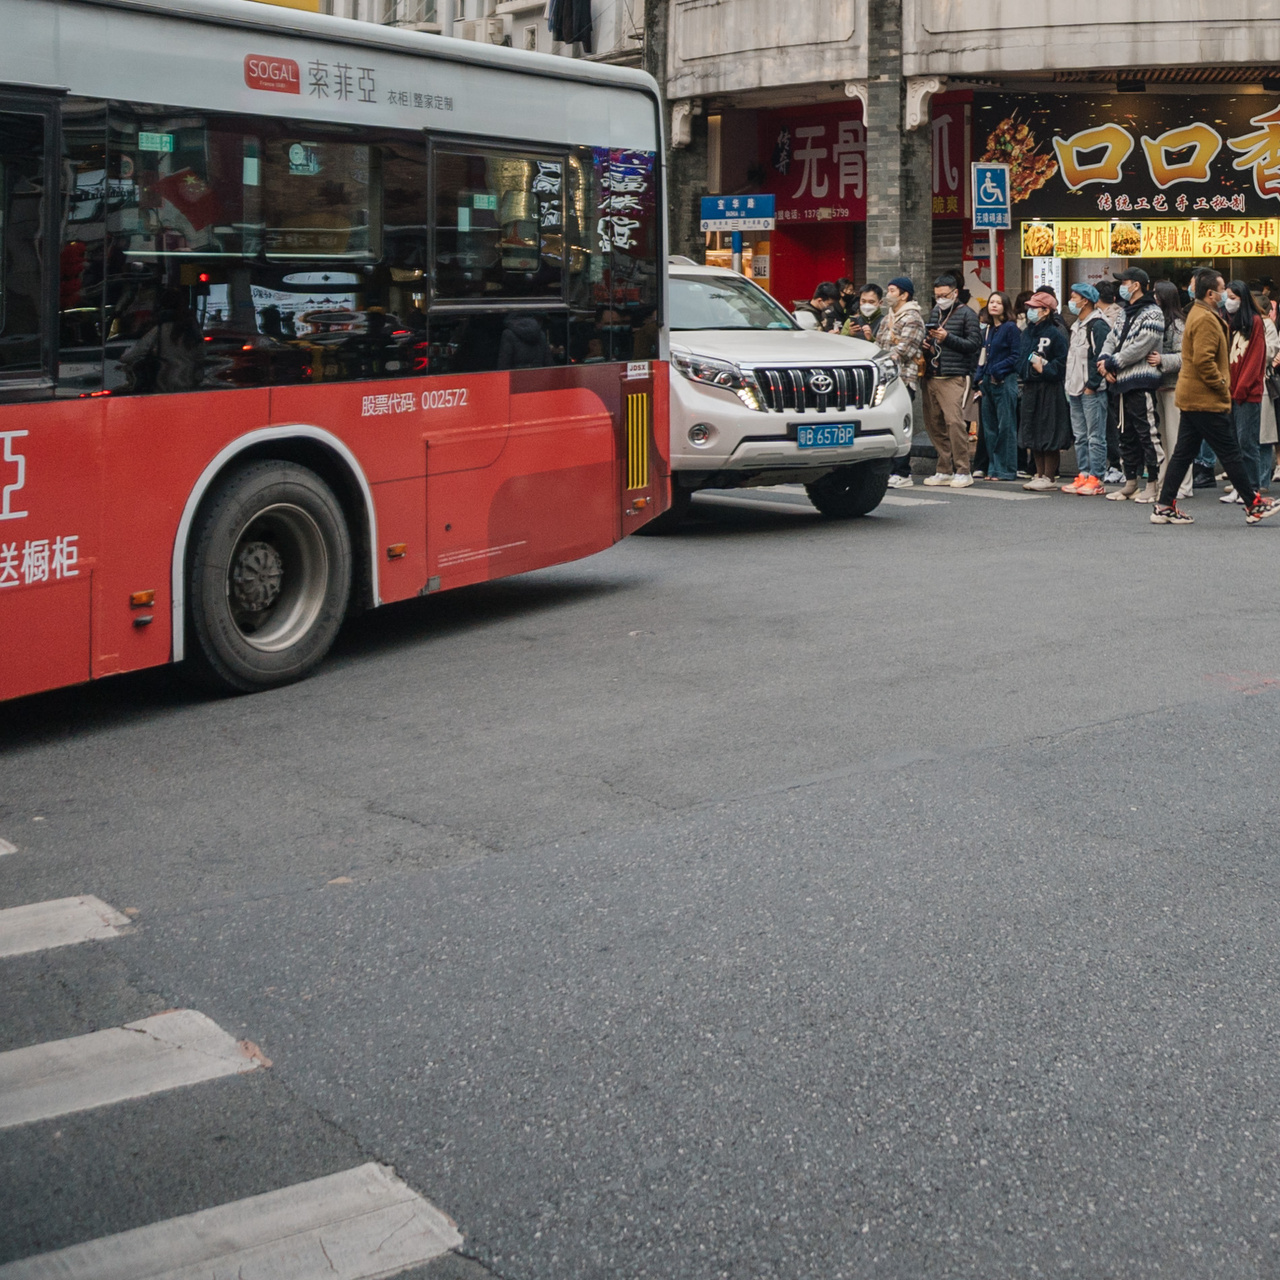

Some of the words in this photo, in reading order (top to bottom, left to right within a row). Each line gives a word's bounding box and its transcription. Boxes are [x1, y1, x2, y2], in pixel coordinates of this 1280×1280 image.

[249, 59, 297, 82] SOGAL
[308, 59, 377, 103] 索菲亞
[387, 89, 408, 107] 衣柜
[413, 92, 454, 111] 整家定制
[932, 195, 958, 214] 脆爽
[1057, 226, 1105, 253] 無骨鳳爪
[1198, 221, 1275, 239] 經典小串
[1203, 239, 1271, 256] 6元30串
[1038, 337, 1052, 352] P
[421, 388, 468, 410] 002572
